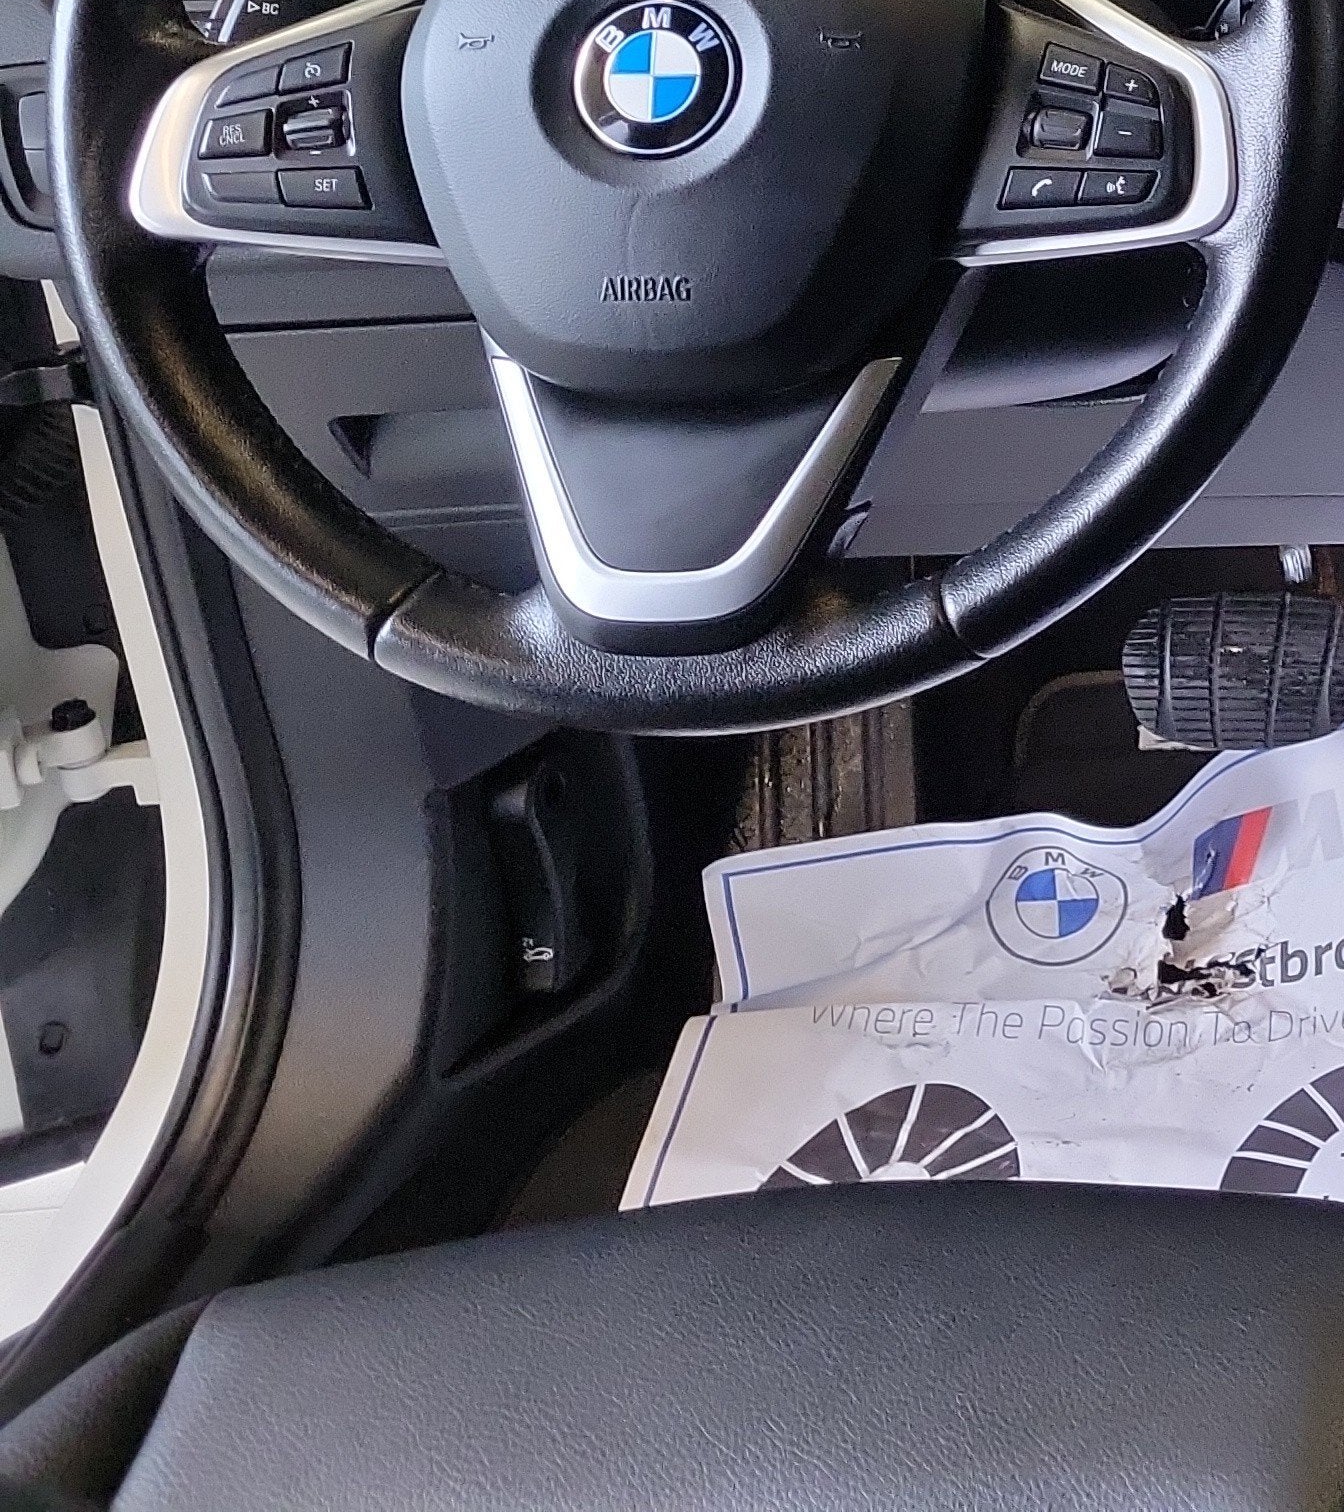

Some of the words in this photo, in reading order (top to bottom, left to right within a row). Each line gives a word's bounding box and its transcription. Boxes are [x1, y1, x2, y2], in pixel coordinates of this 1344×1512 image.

[594, 6, 721, 54] BMW
[1051, 59, 1088, 78] MODE
[219, 133, 245, 147] CNCL
[314, 178, 339, 193] SET
[599, 274, 692, 303] AIRBAG
[1008, 850, 1104, 881] BMW
[952, 1001, 1025, 1040] The
[1037, 1003, 1188, 1048] Passion
[1202, 1009, 1253, 1047] To
